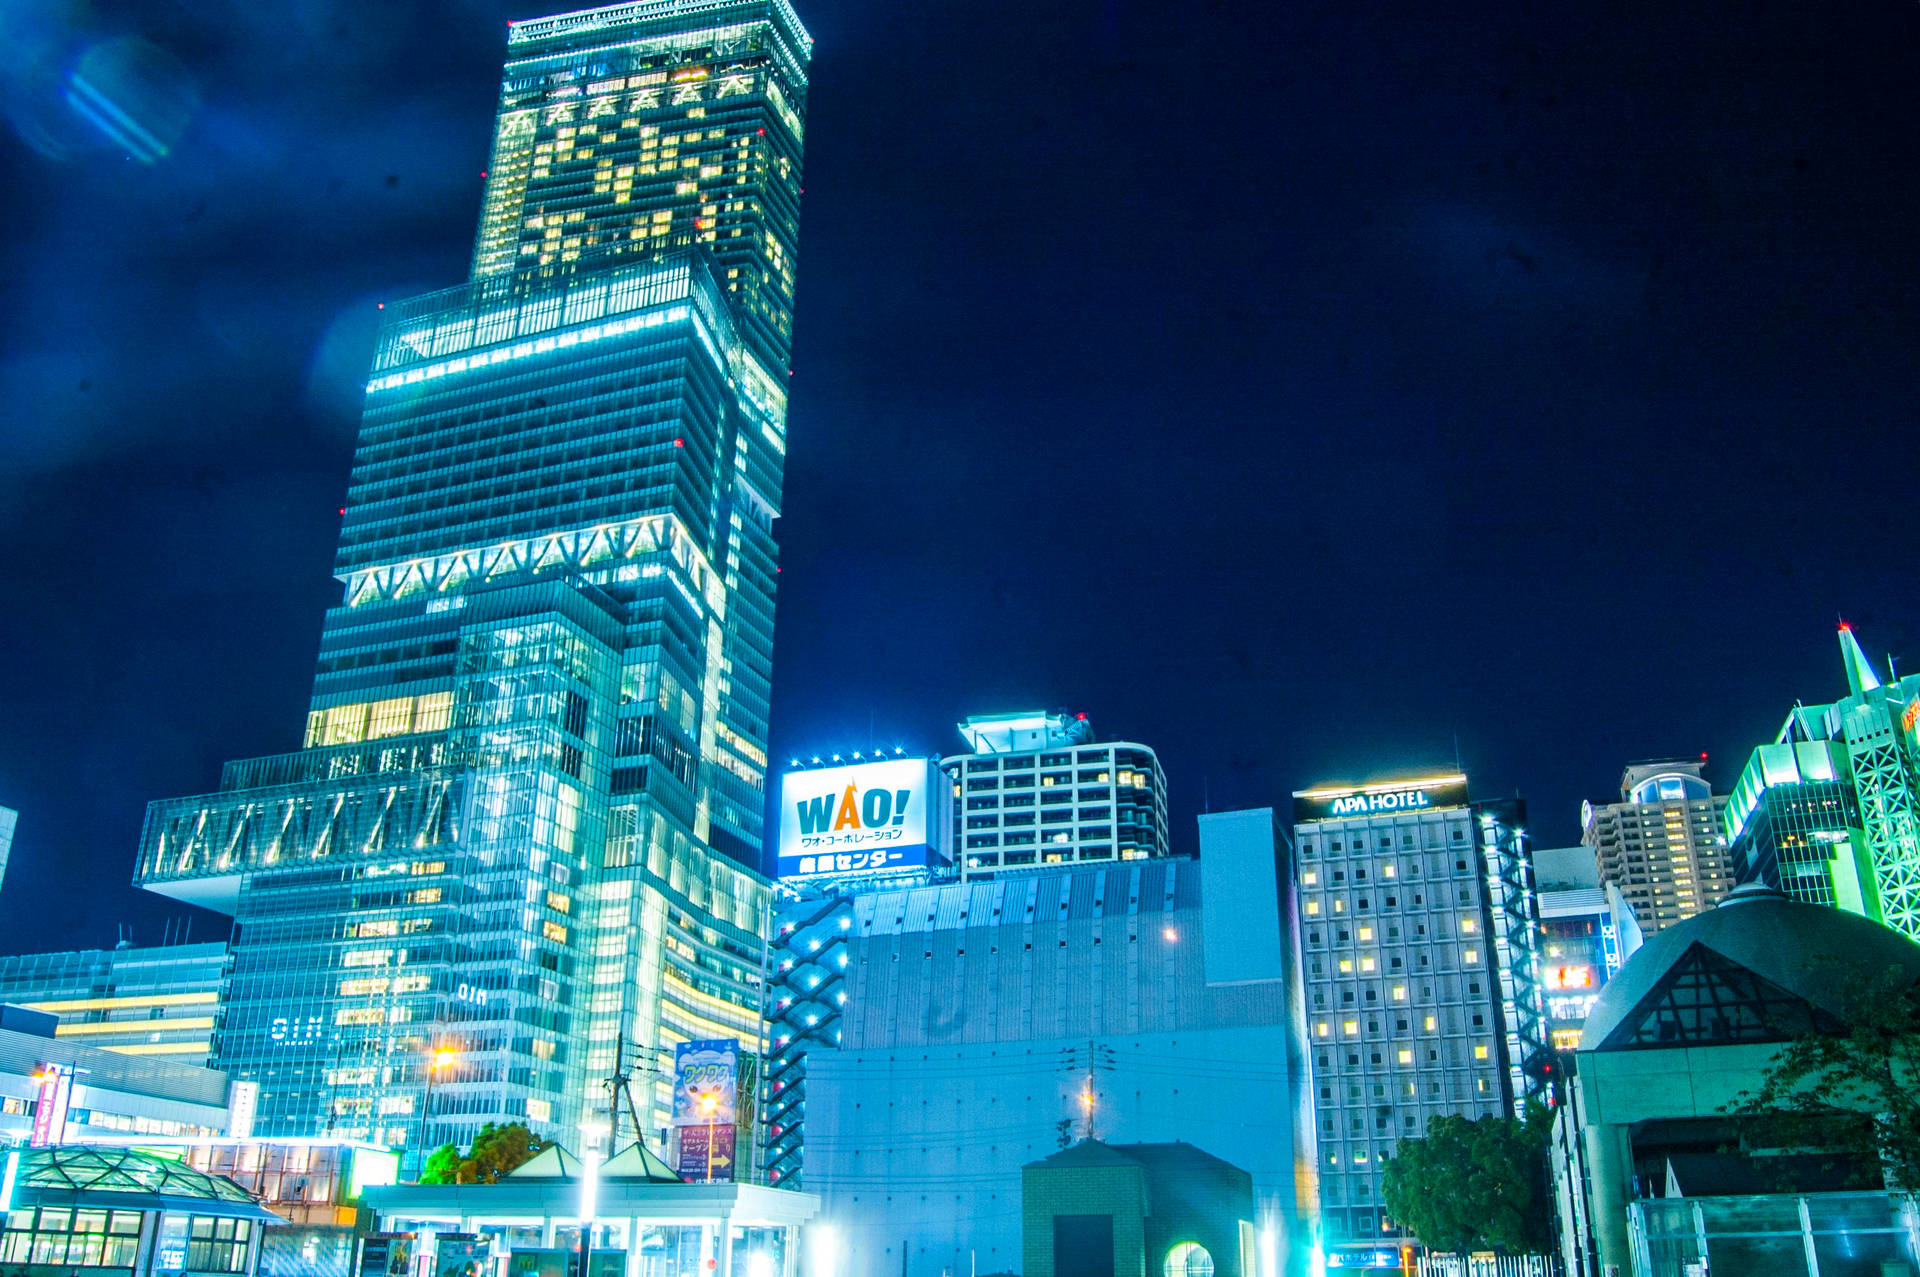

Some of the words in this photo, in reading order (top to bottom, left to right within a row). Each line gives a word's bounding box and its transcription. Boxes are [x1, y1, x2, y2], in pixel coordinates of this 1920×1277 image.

[797, 776, 911, 835] WAO!
[1332, 797, 1368, 814] APA
[1369, 791, 1428, 809] HOTEL
[801, 829, 903, 847] ワオ・コーポレーション
